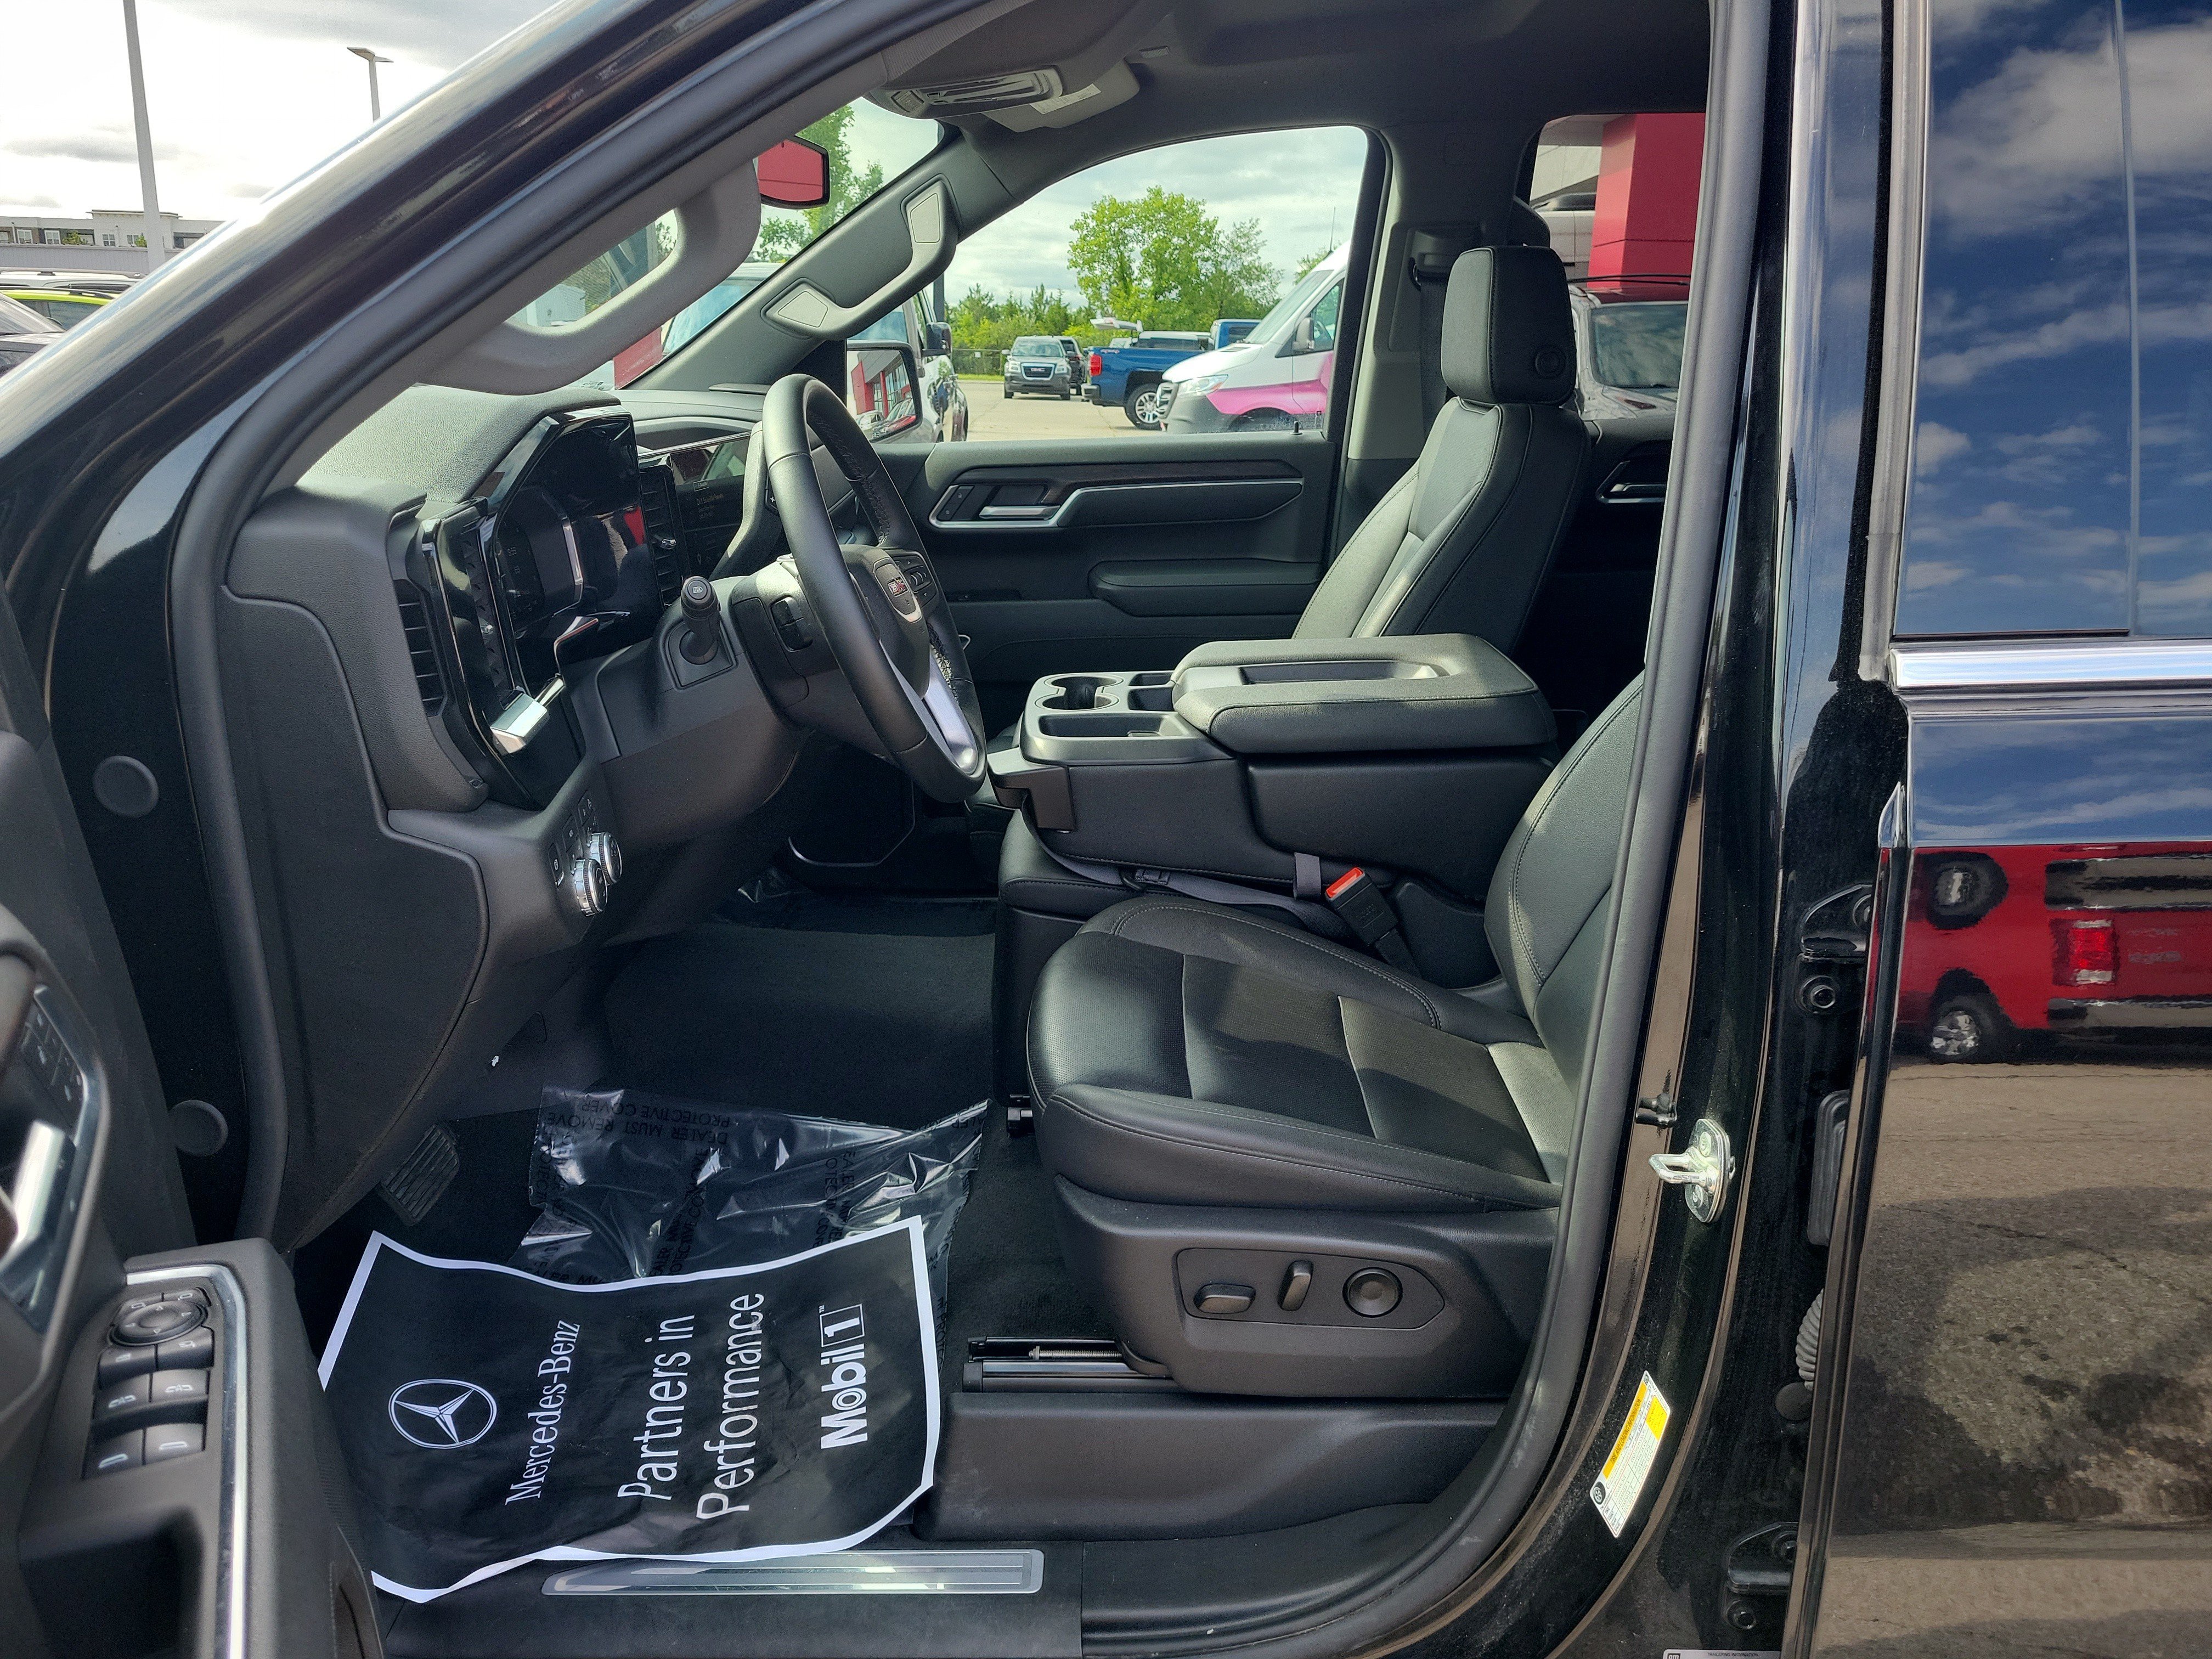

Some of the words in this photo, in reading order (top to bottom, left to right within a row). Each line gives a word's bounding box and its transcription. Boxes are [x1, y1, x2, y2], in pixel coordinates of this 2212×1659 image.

[582, 1100, 636, 1116] COVER
[641, 1105, 730, 1128] PROTECTIVE
[548, 1112, 614, 1132] REMOVE
[624, 1121, 663, 1137] MUST
[672, 1127, 728, 1145] DEALER
[668, 1221, 698, 1276] OTECTIVE
[644, 1314, 695, 1343] in
[696, 1293, 764, 1519] Performance
[820, 1343, 868, 1449] Mobil
[505, 1320, 580, 1505] Mercedes-Benz
[617, 1351, 691, 1500] Partners
[1618, 1423, 1630, 1446] LOADING
